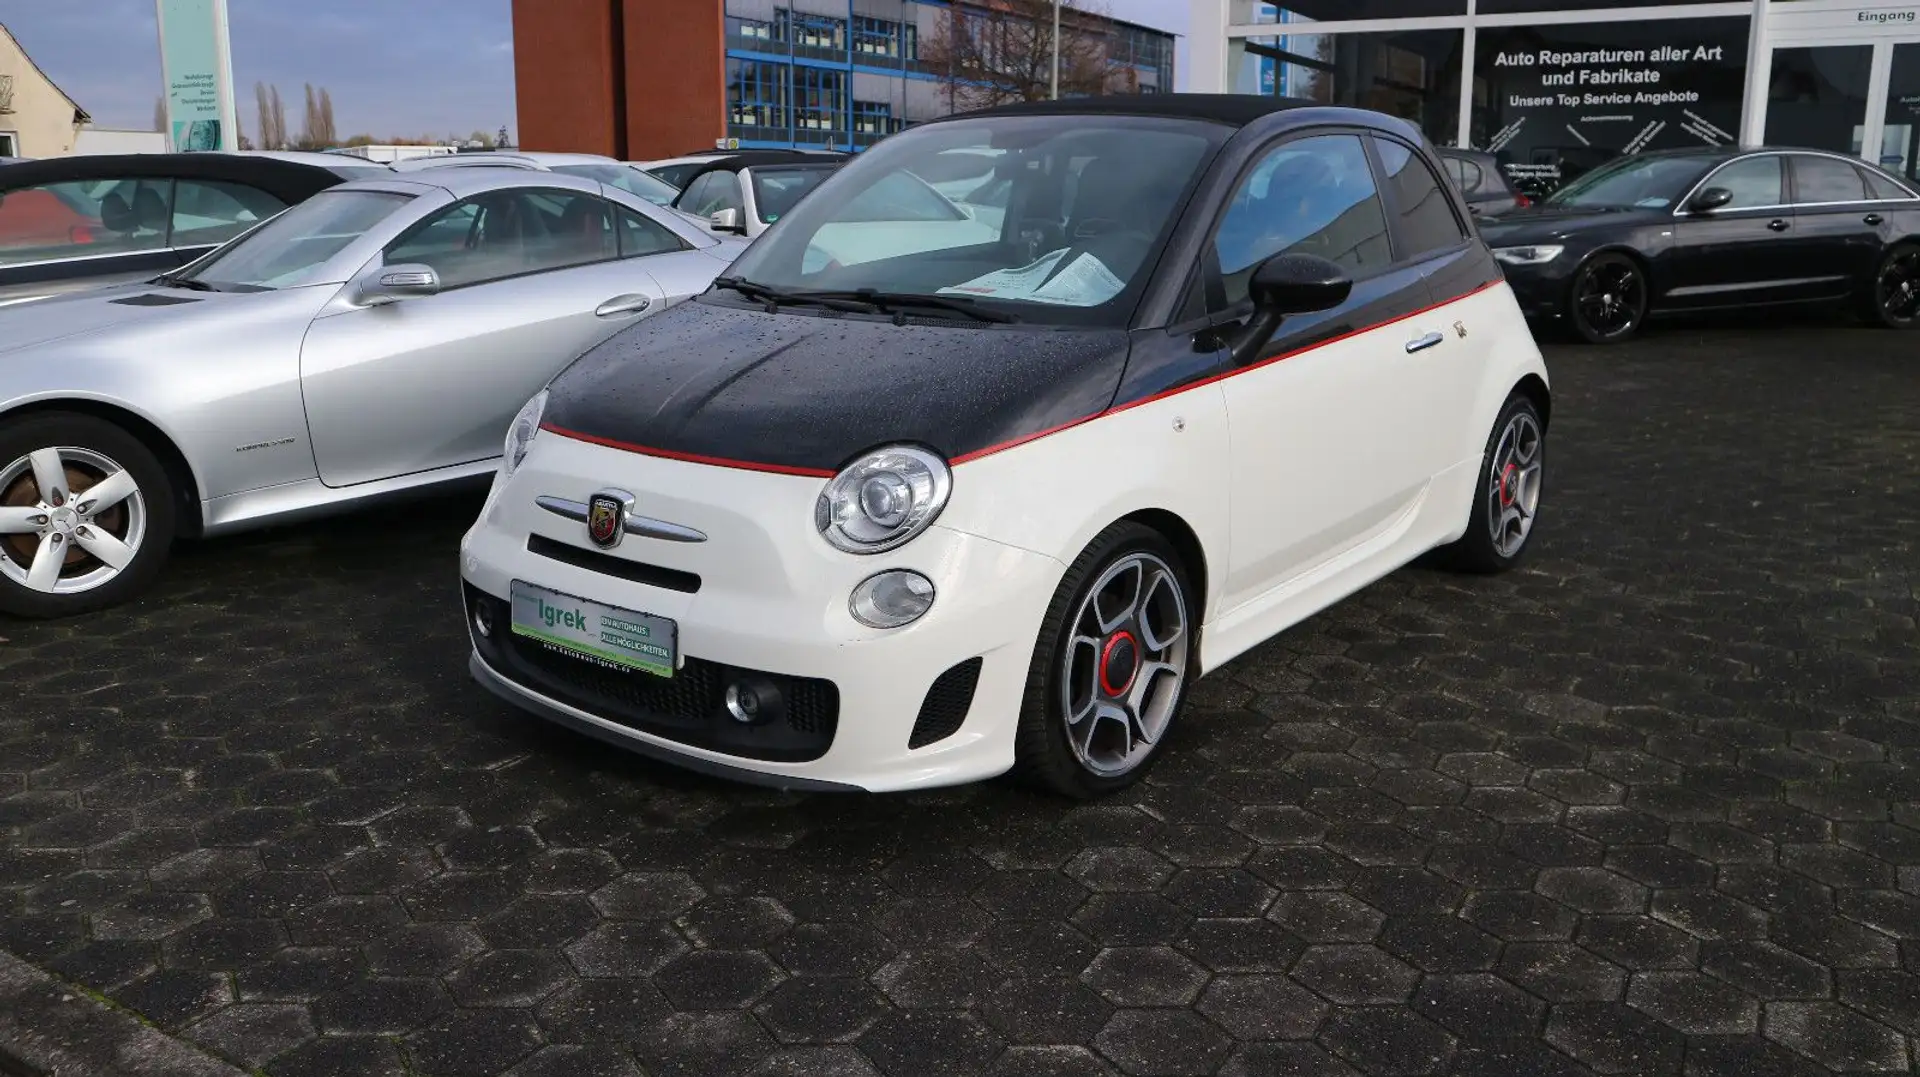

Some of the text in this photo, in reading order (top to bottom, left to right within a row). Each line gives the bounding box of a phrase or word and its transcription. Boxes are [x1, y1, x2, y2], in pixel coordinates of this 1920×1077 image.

[1857, 11, 1915, 22] Eingang
[1494, 45, 1723, 67] Auto Reparaturen aller Art
[1542, 68, 1660, 85] und Fabrikate
[1510, 91, 1699, 107] Unsere Top Service Angebote
[538, 598, 587, 632] Igrek
